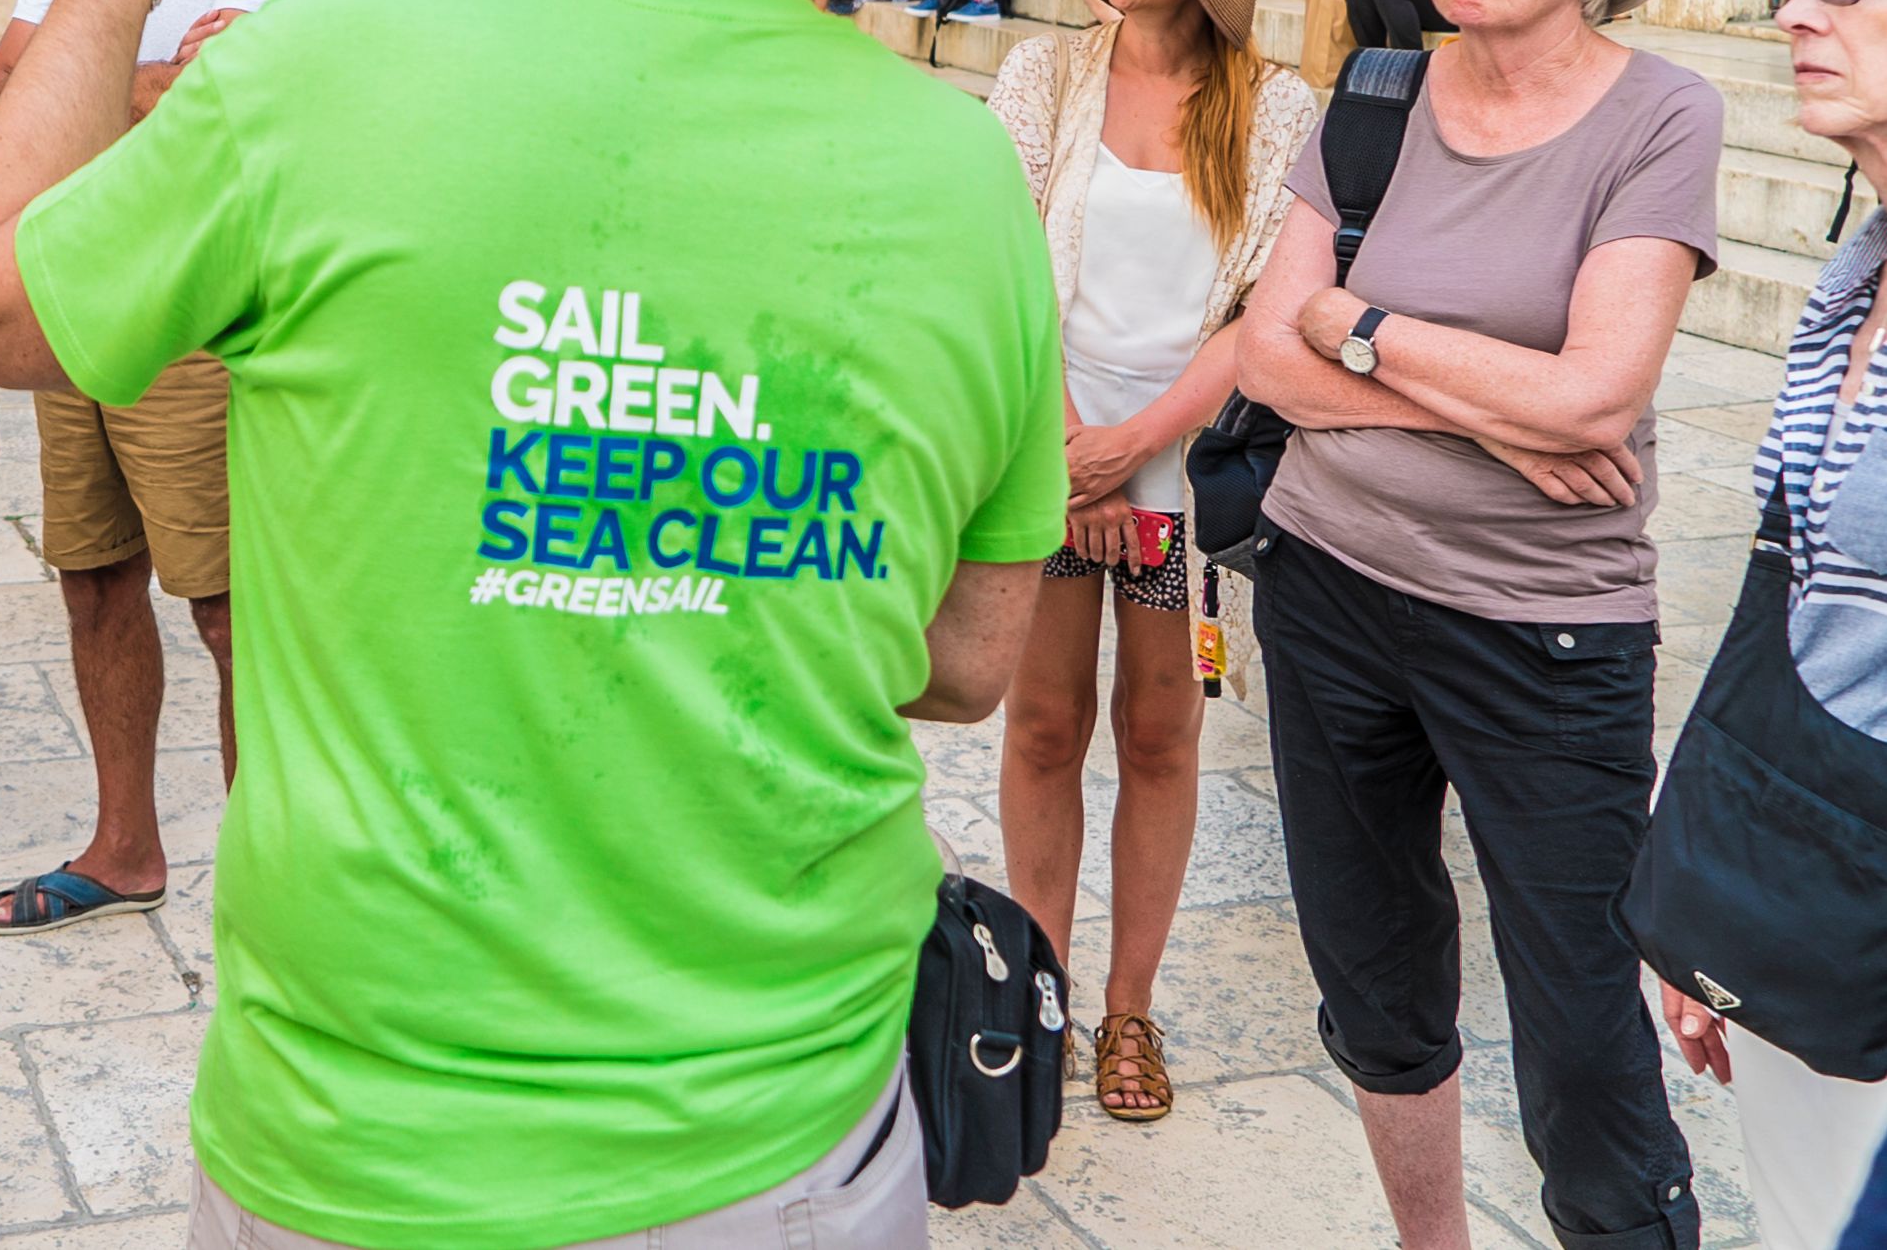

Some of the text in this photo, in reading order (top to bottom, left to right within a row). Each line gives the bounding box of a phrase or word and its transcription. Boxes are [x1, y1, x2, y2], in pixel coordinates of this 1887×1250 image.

[493, 279, 665, 362] SAIL
[490, 355, 772, 441] GREEN.
[486, 427, 862, 513] KEEP OUR
[477, 500, 889, 581] SEA CLEAN.
[469, 567, 729, 617] #GREENSAIL
